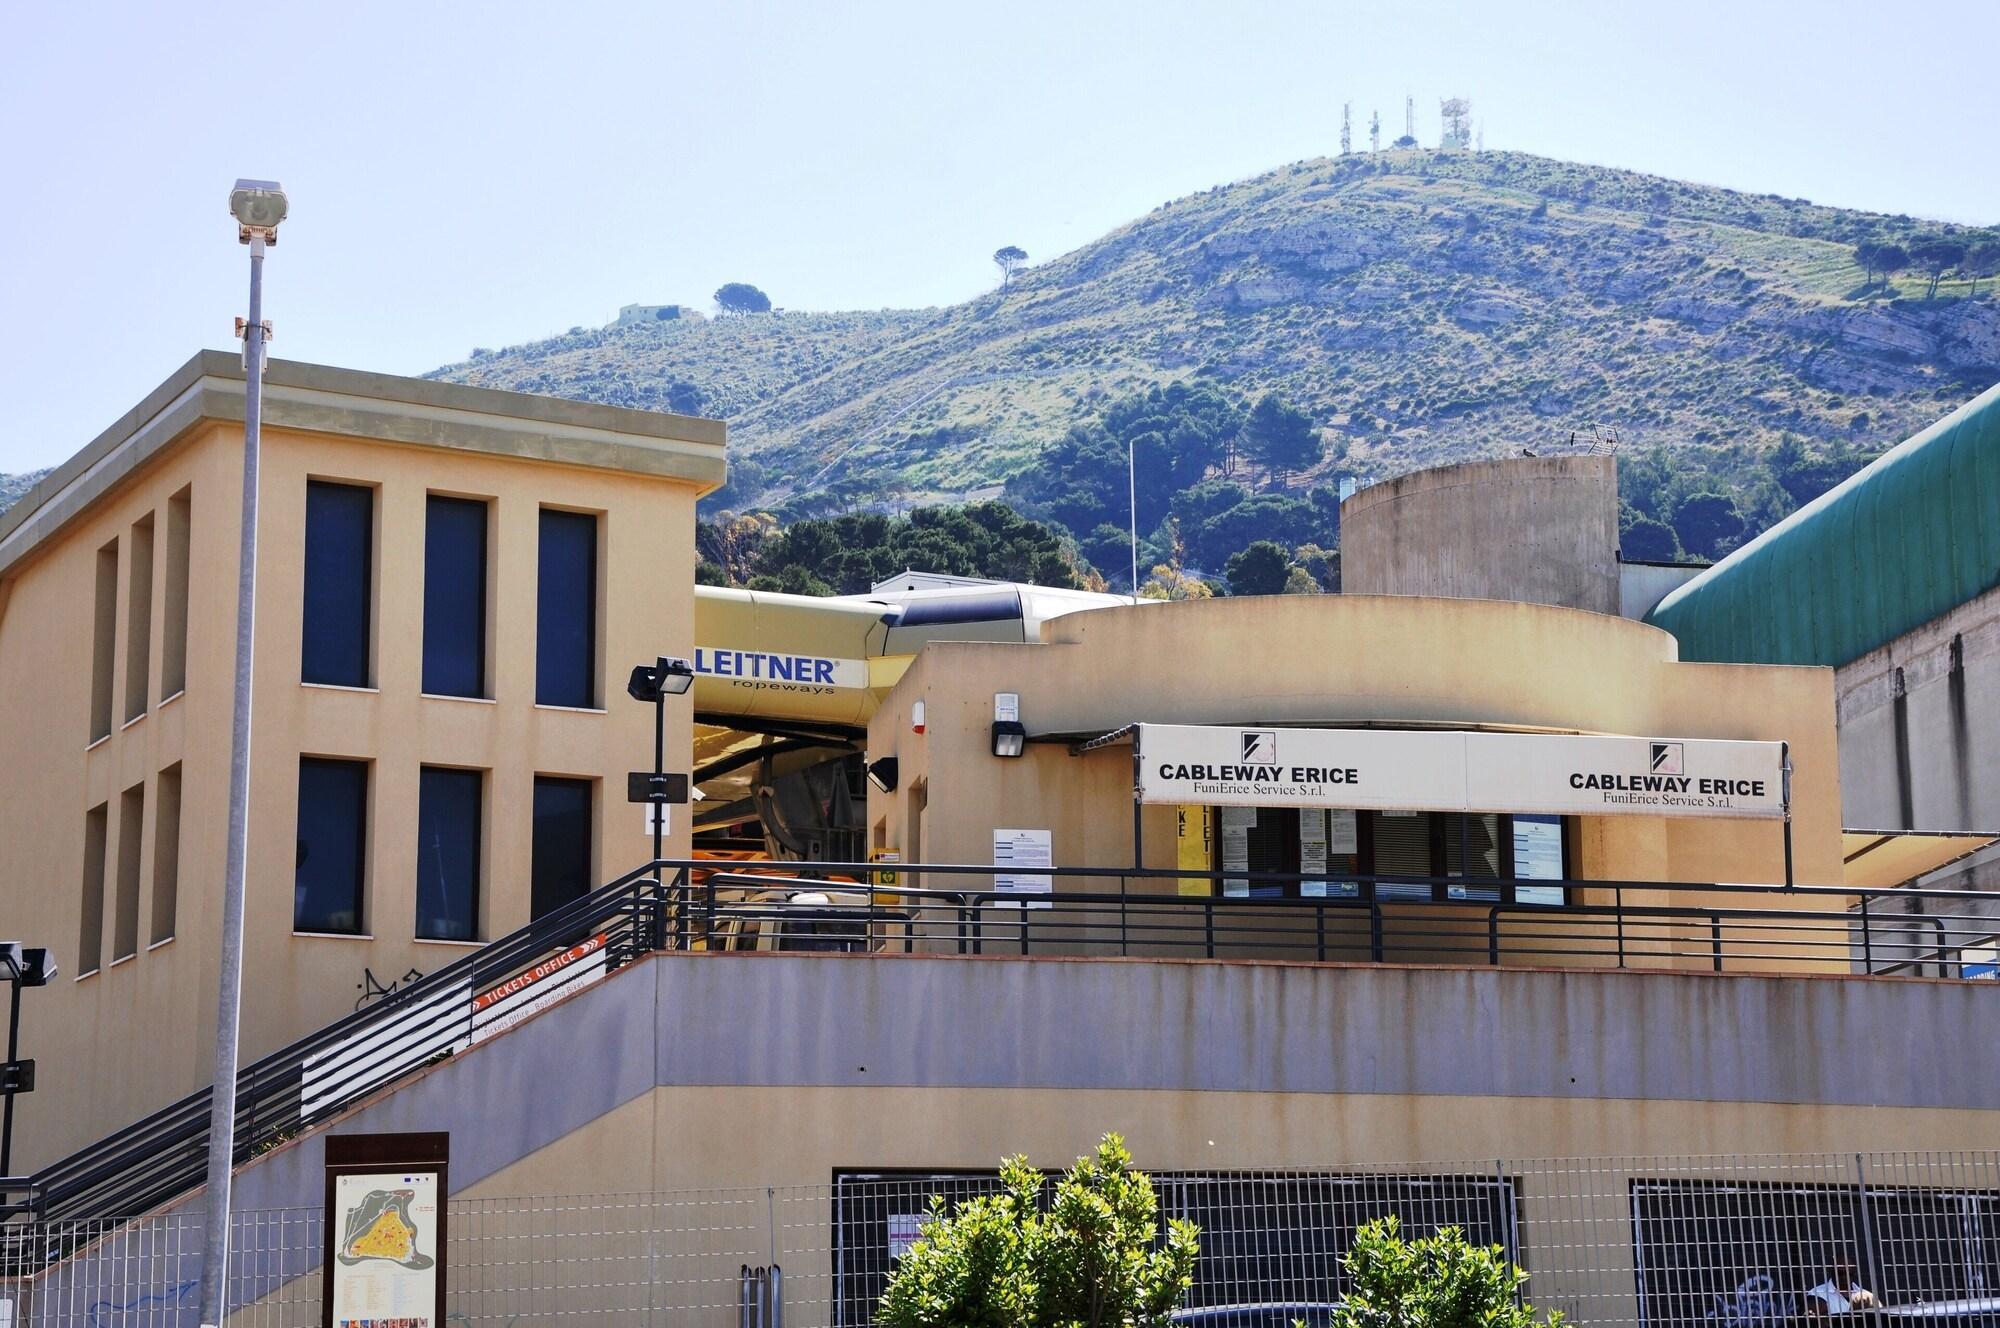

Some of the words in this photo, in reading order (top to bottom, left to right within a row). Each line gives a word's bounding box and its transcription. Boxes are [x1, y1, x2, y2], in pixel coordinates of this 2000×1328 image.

[695, 649, 835, 684] LEITNER
[733, 680, 835, 695] ropeways
[1159, 764, 1284, 784] CABLEWAY
[1291, 767, 1359, 784] ERICE
[1570, 773, 1691, 793] CABLEWAY
[1699, 778, 1765, 797] ERICE
[1193, 782, 1250, 795] FuniErice
[1253, 783, 1296, 797] Service
[1299, 784, 1326, 797] S.r.l.
[1603, 791, 1658, 806] FuniErice
[1662, 793, 1704, 807] Service
[1707, 795, 1733, 809] S.r.l.
[485, 973, 532, 1003] TICKETS
[535, 951, 575, 977] OFFICE
[484, 1019, 509, 1037] Tickets
[509, 1009, 529, 1028] Office
